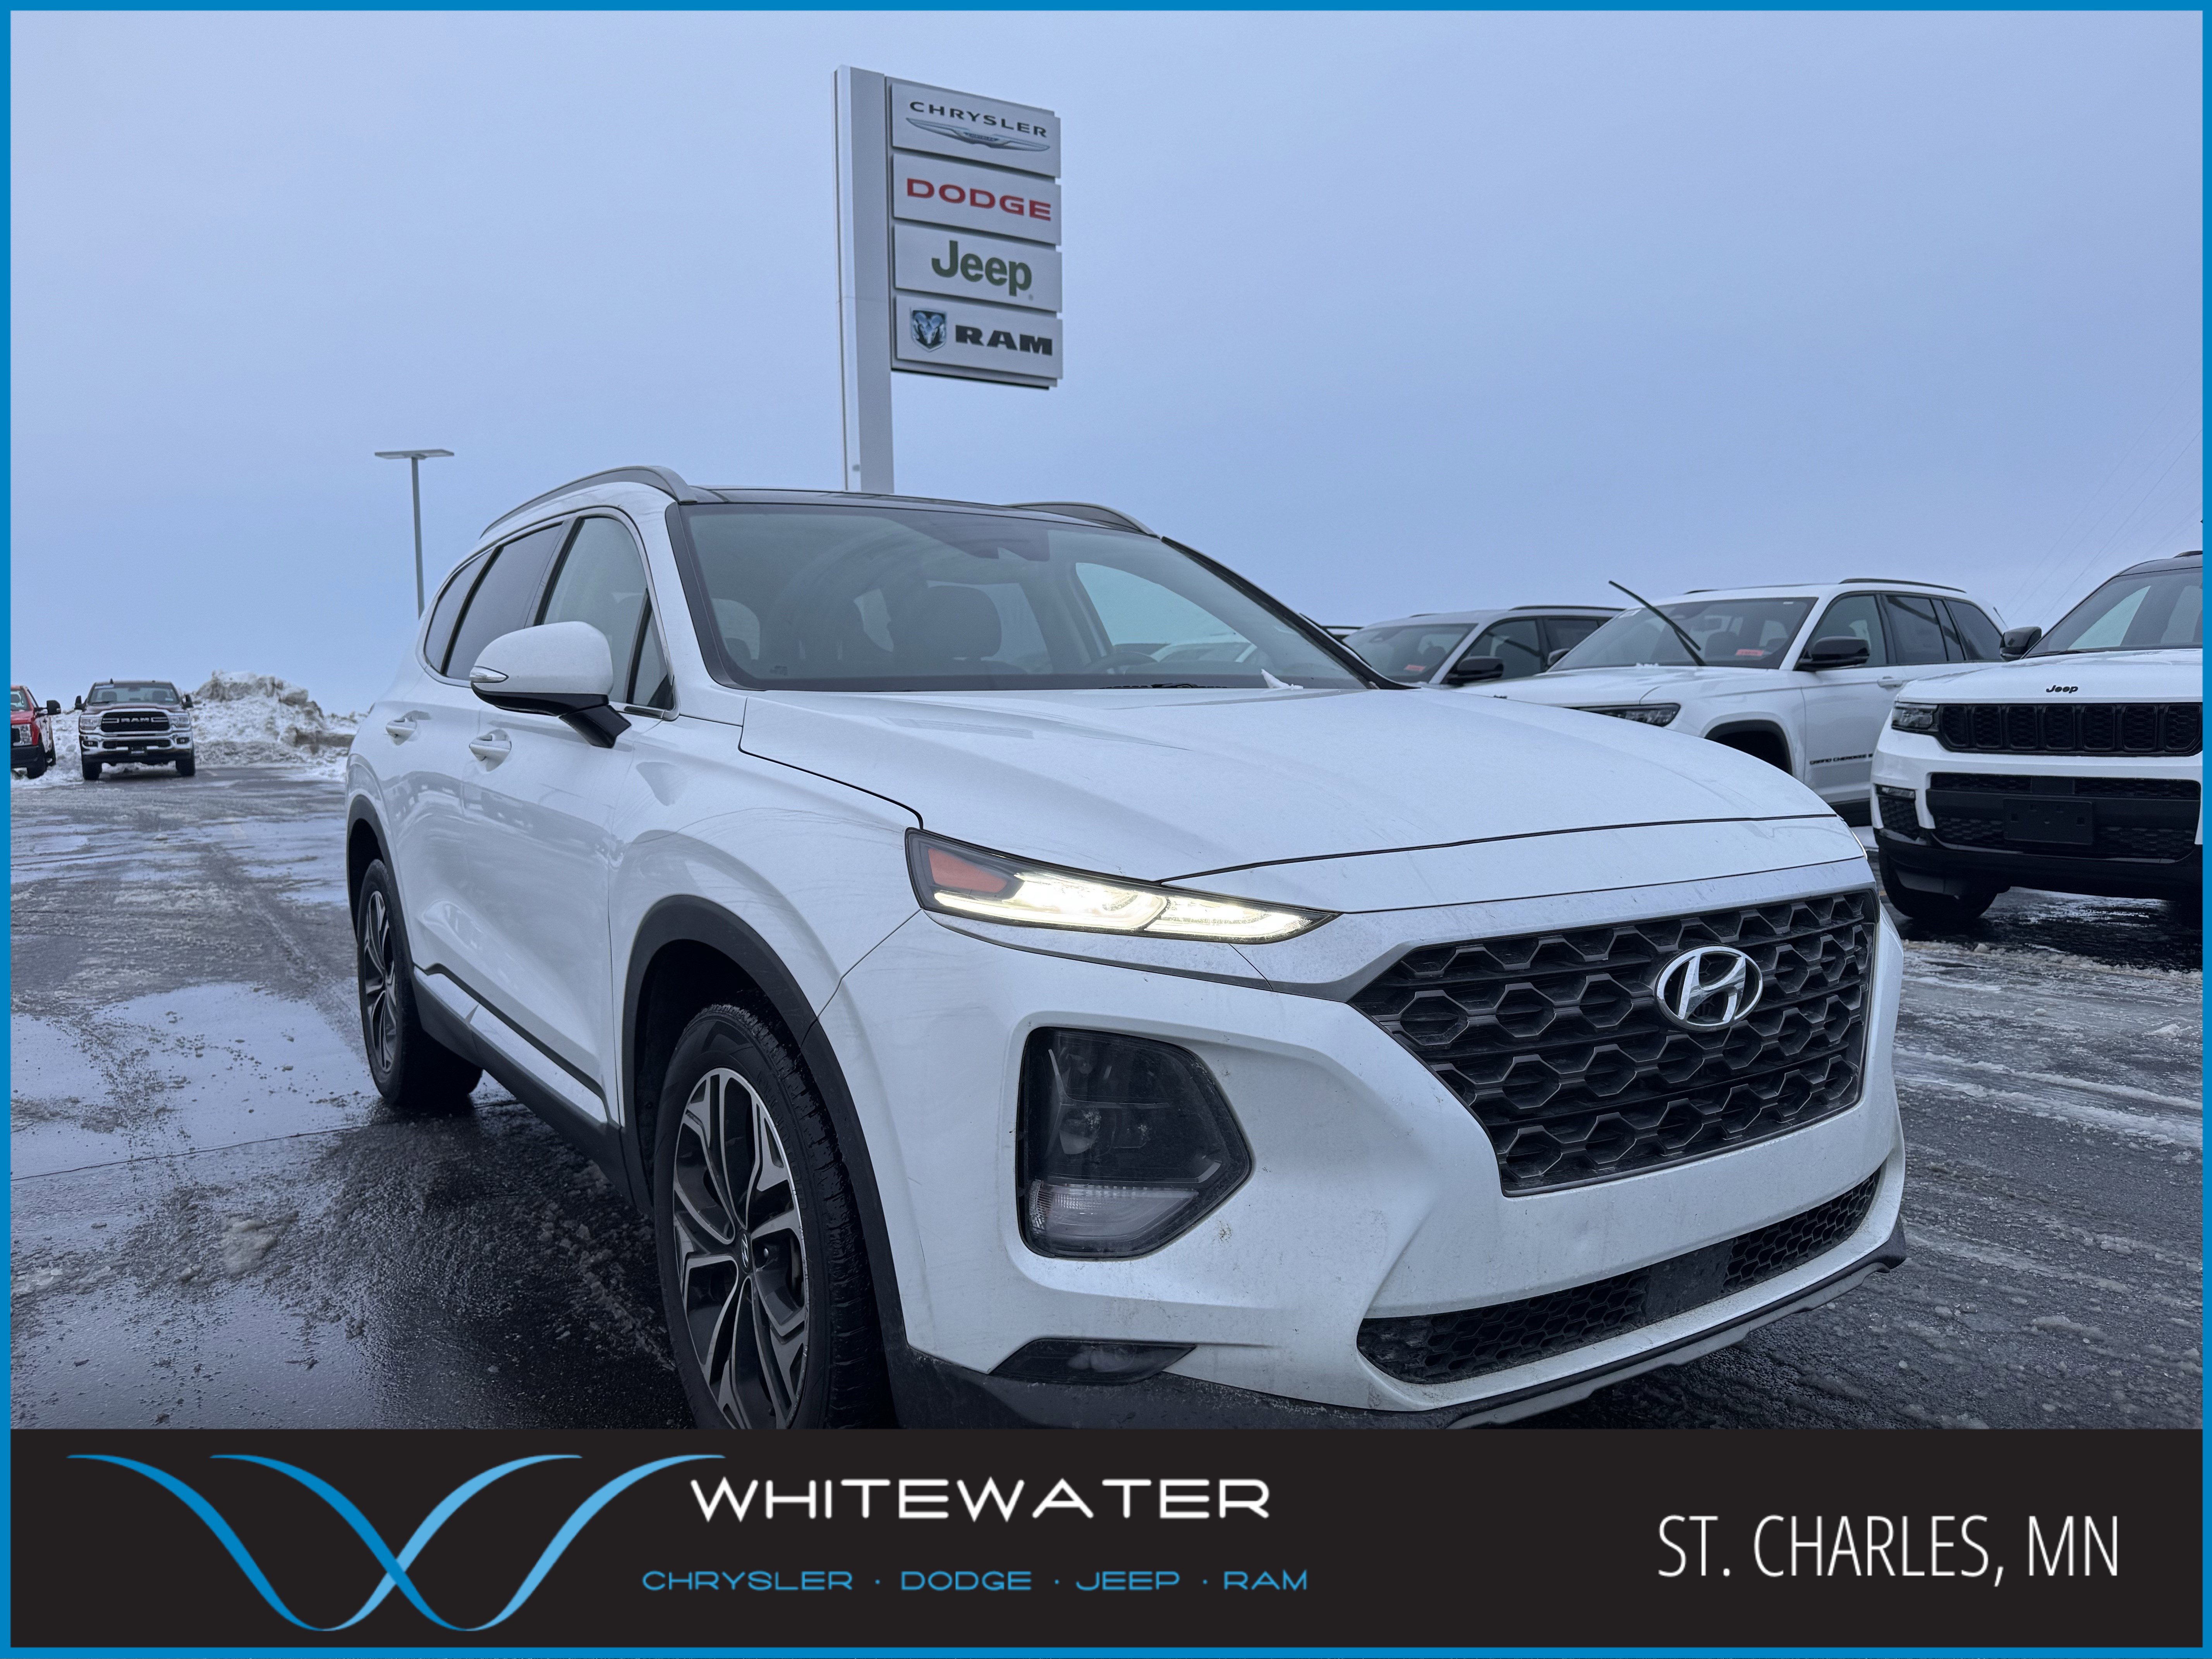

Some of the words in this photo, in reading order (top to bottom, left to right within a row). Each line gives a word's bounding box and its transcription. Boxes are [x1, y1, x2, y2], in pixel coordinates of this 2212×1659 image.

[909, 101, 1047, 138] CHRYSLER
[907, 178, 1051, 222] DODGE
[931, 240, 1032, 297] Jeep
[955, 325, 1053, 356] RAM
[2046, 685, 2078, 694] Jeep
